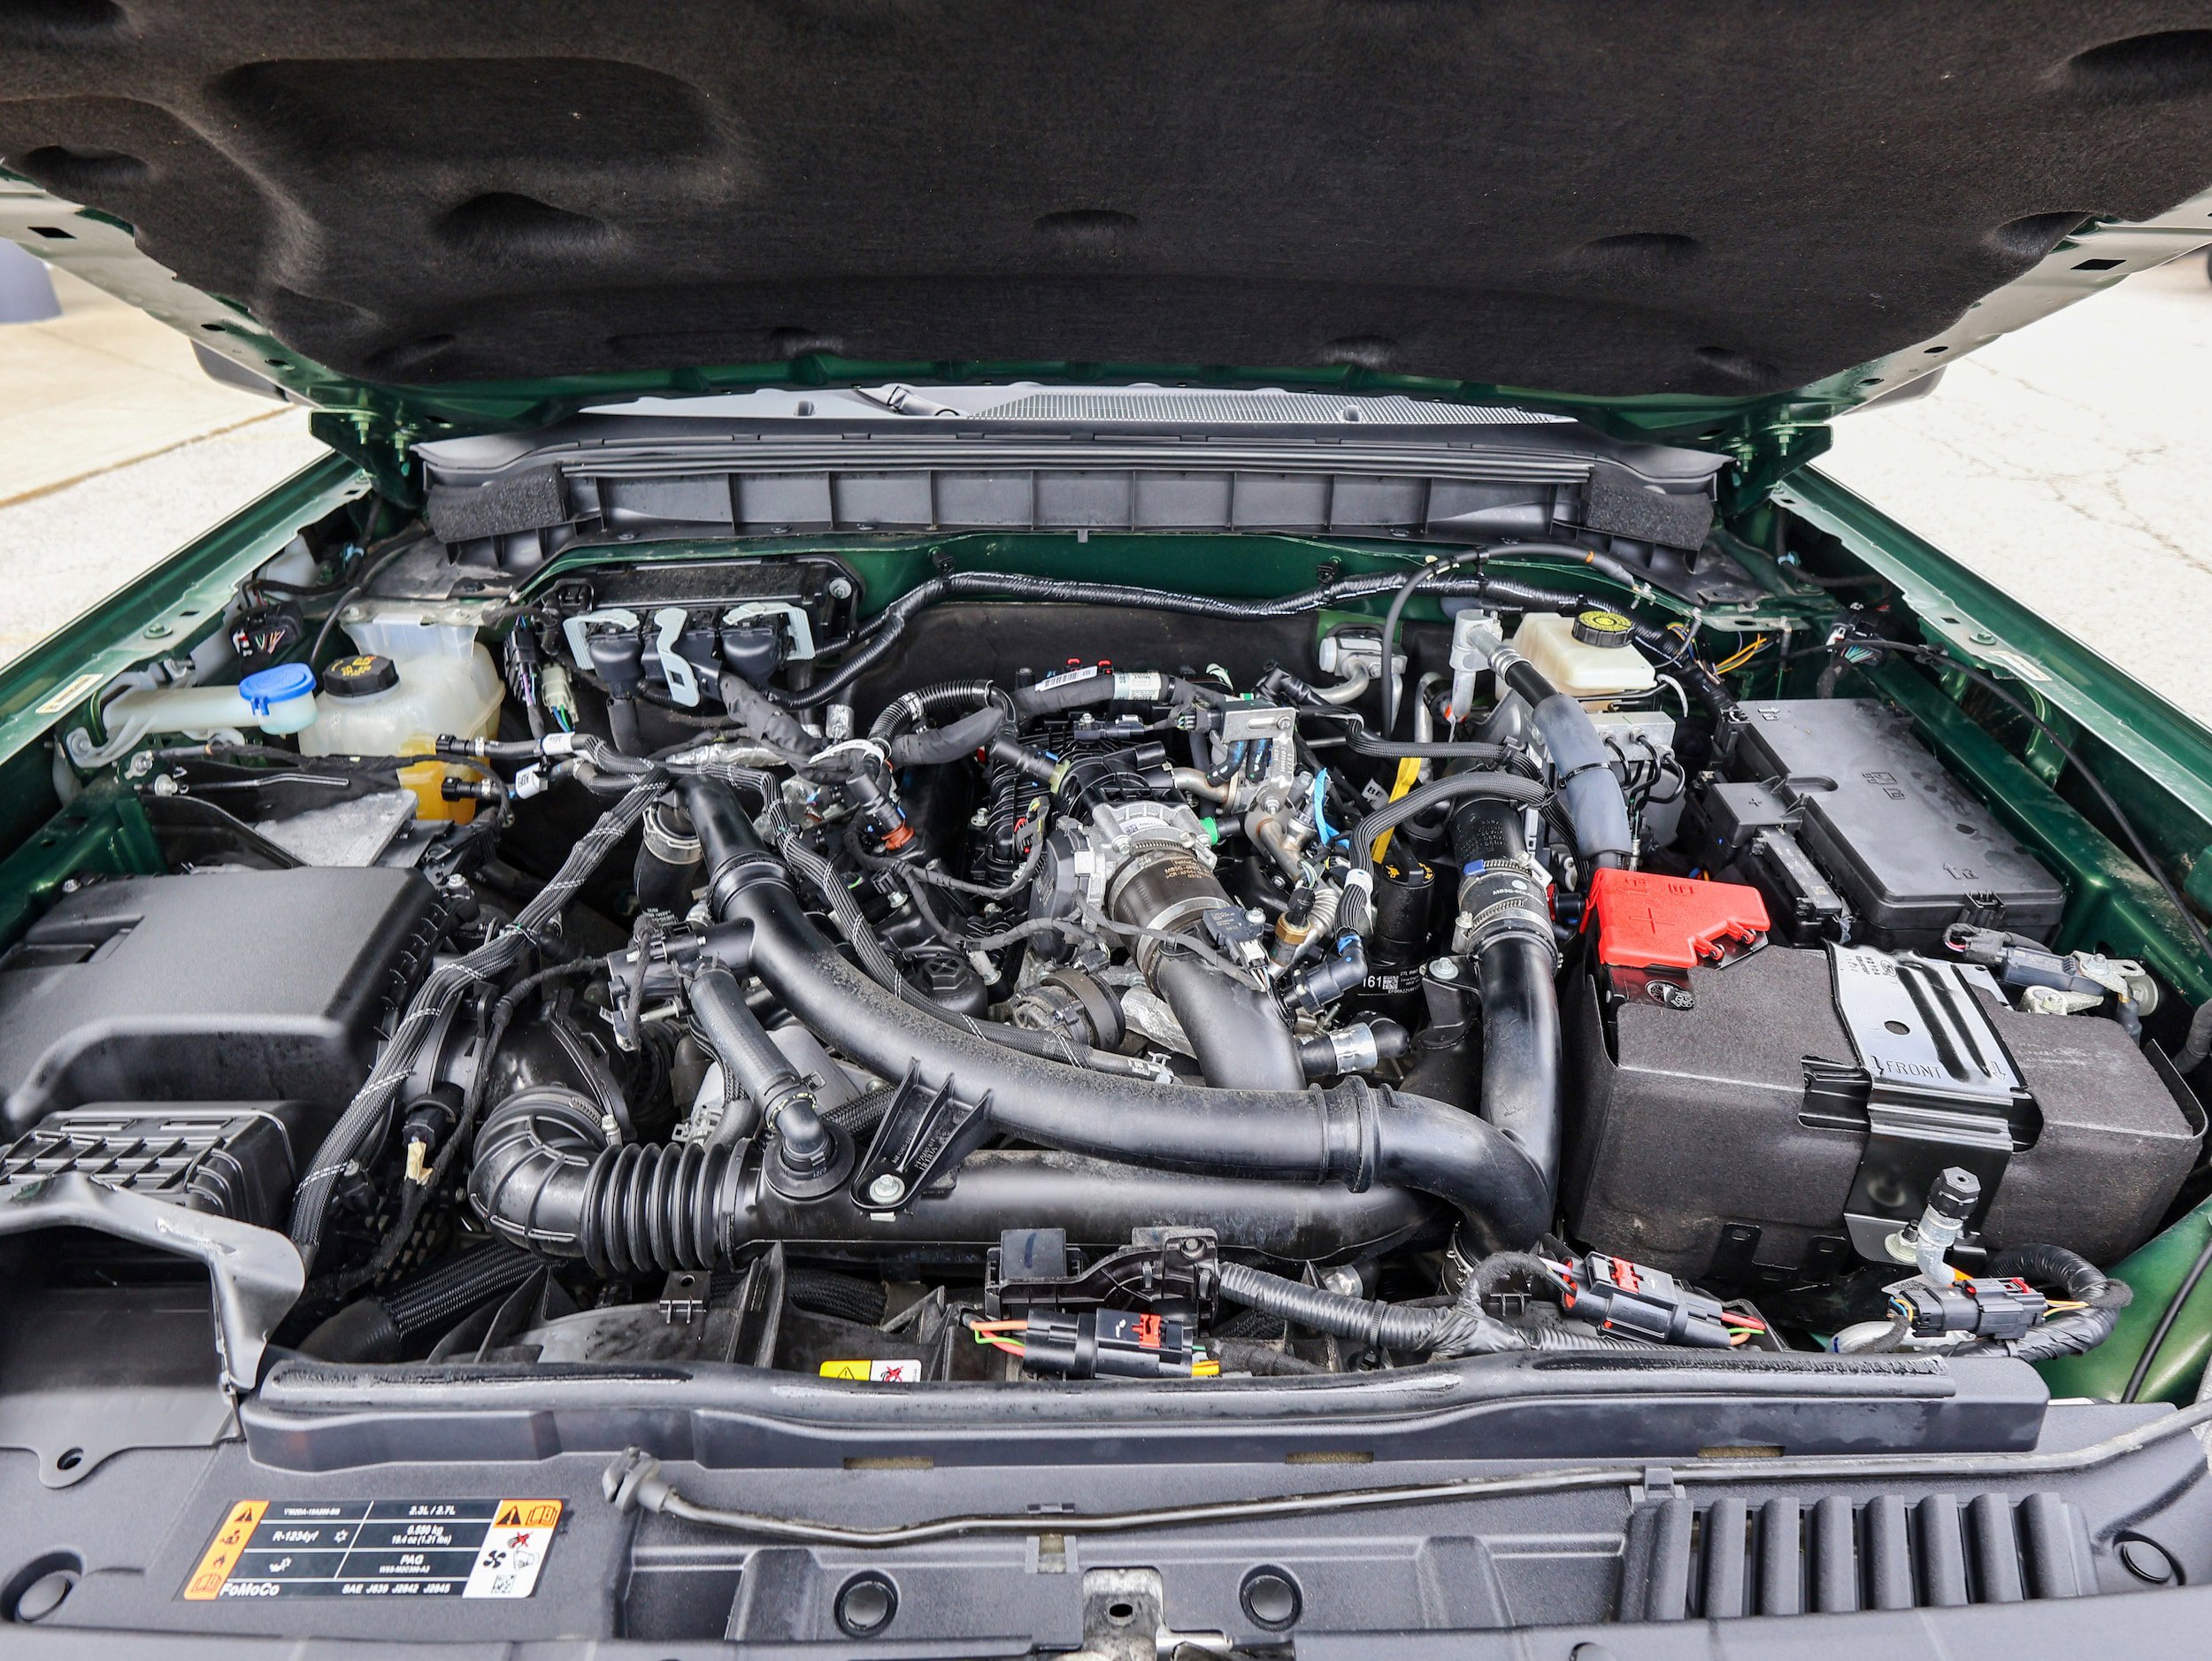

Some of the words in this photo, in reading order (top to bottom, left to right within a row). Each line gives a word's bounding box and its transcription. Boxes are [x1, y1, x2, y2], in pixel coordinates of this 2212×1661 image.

[1886, 1060, 1942, 1079] FRONT
[409, 1505, 429, 1515] 2.3L
[436, 1505, 456, 1515] 2.7L
[272, 1529, 319, 1543] R-1234yf
[431, 1524, 444, 1537] kg
[400, 1554, 425, 1565] PAG
[219, 1582, 280, 1597] FoMoCo
[342, 1583, 364, 1595] SAE
[365, 1583, 389, 1595] J639
